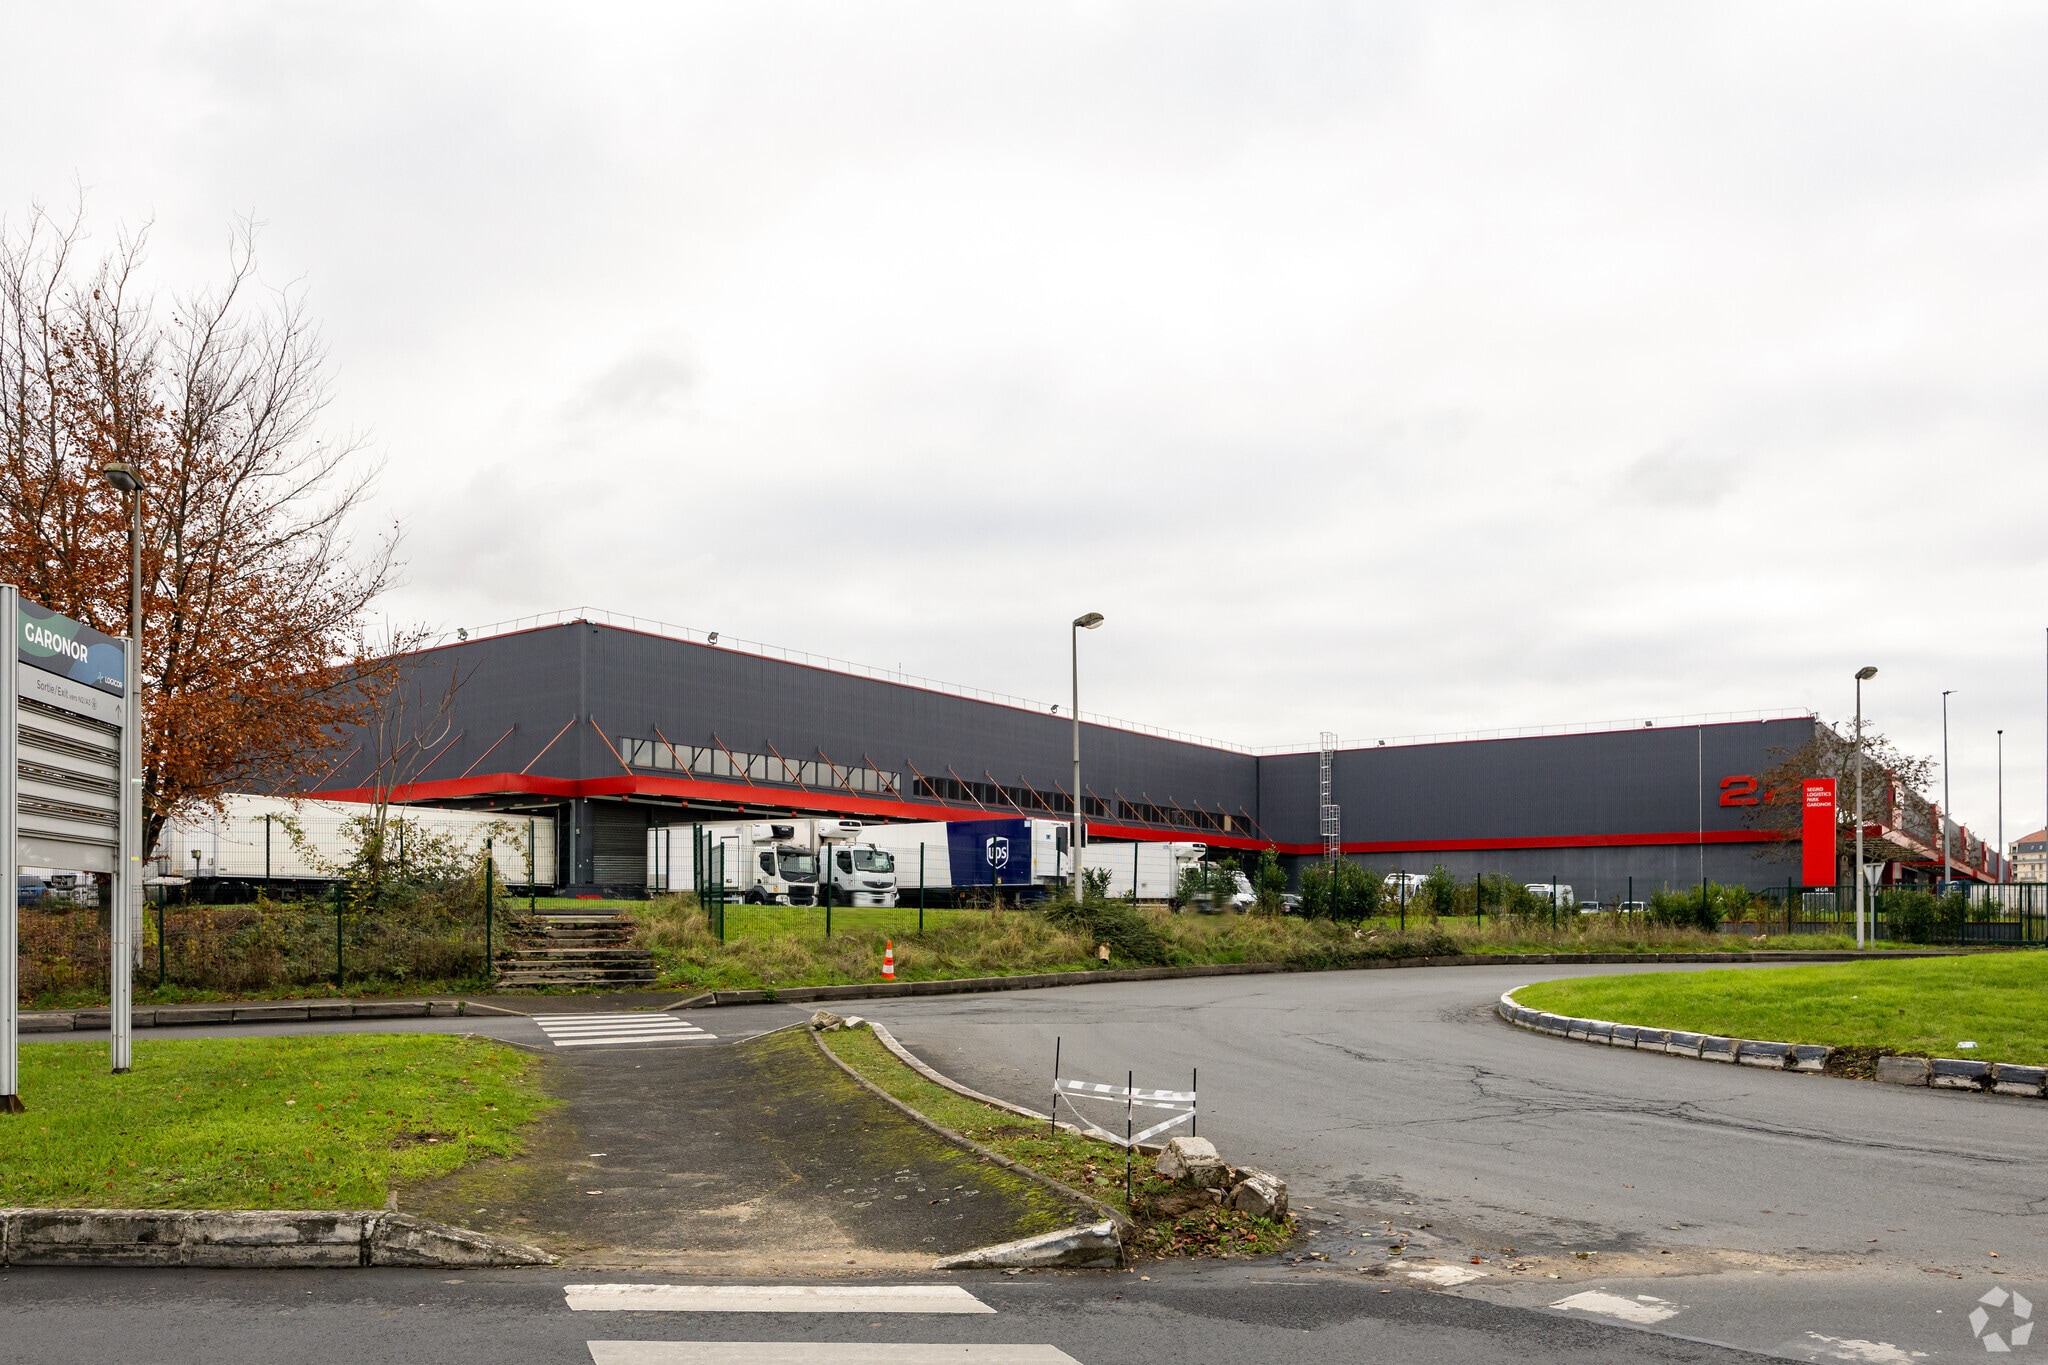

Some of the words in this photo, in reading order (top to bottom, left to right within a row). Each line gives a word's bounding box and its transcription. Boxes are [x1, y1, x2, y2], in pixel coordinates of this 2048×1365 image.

[25, 622, 88, 664] GARONOR
[36, 679, 69, 699] Sortie/Exit
[104, 676, 123, 689] LOGICOR
